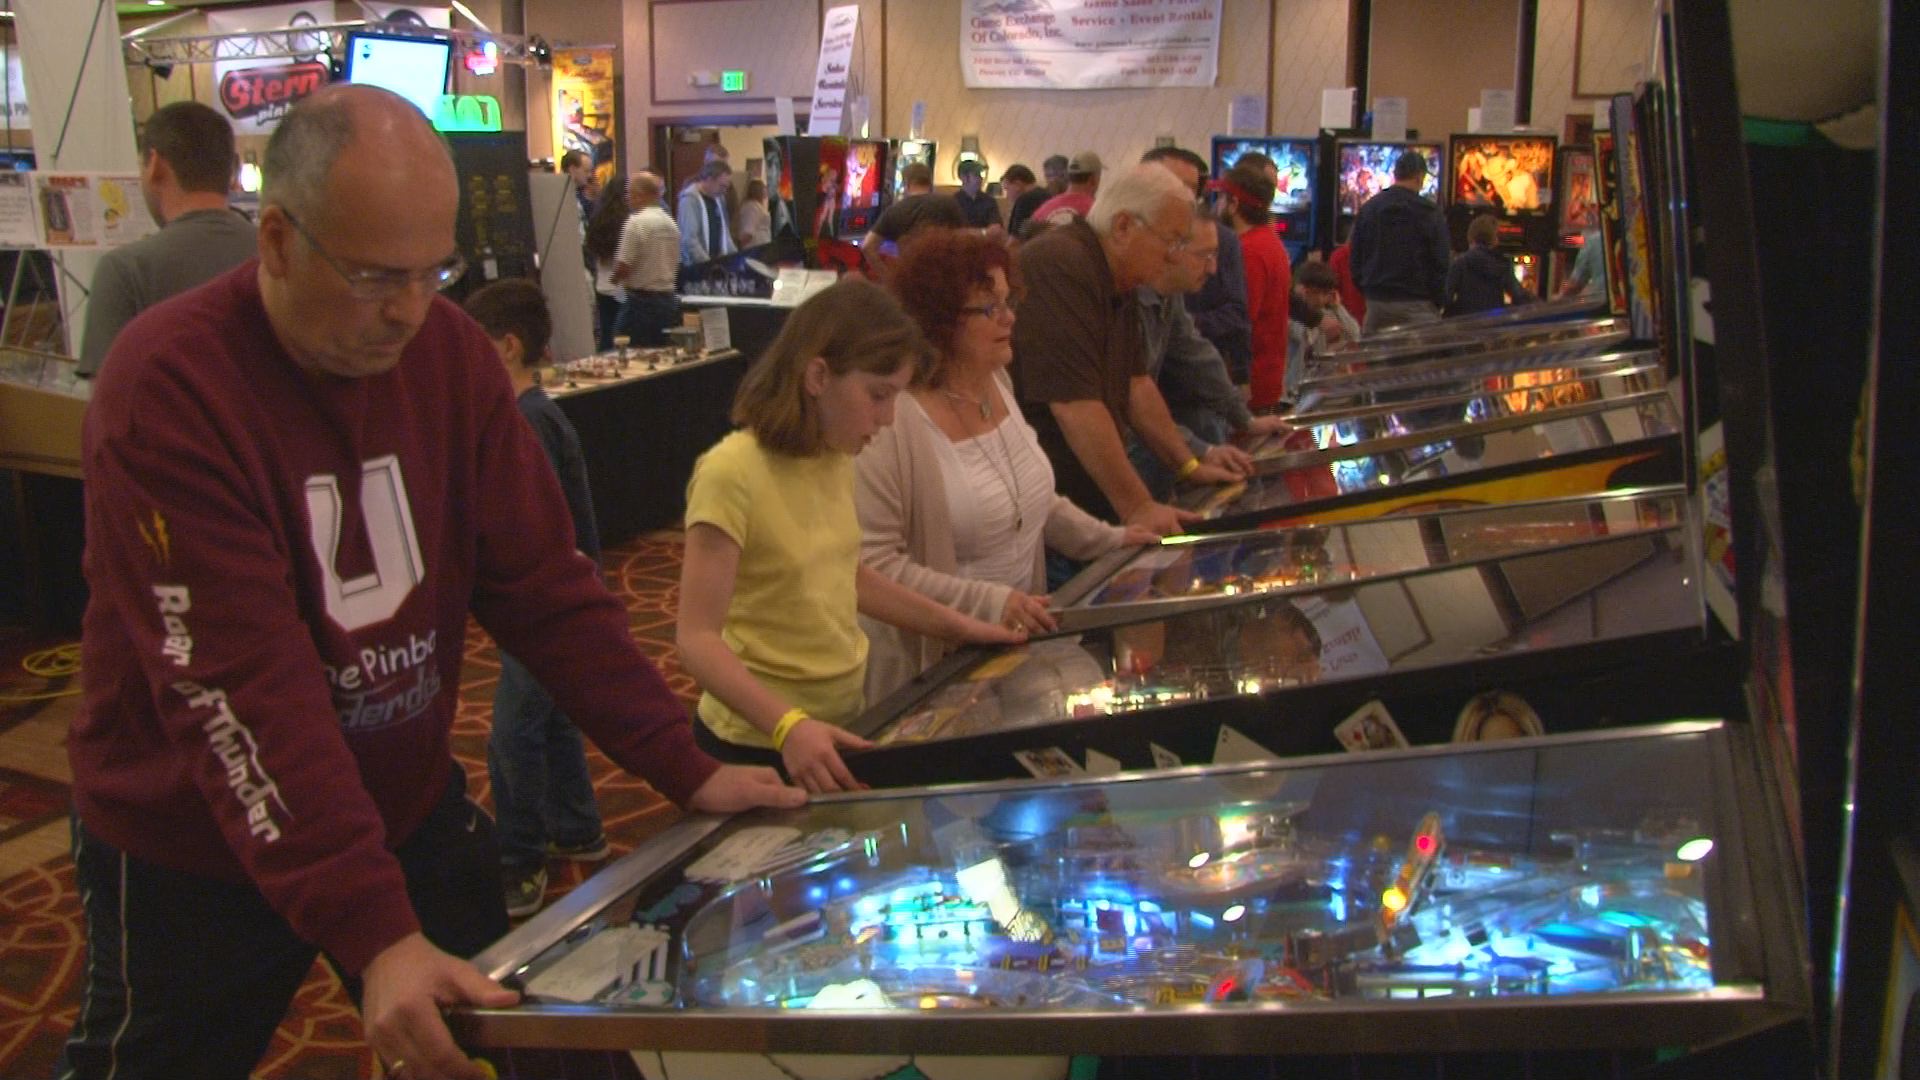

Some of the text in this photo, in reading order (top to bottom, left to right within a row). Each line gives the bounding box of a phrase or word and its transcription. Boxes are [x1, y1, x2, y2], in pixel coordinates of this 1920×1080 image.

[1072, 8, 1214, 26] Service Event Rentals
[229, 71, 319, 106] Stern
[152, 584, 194, 667] Roar
[203, 694, 294, 844] Thunder
